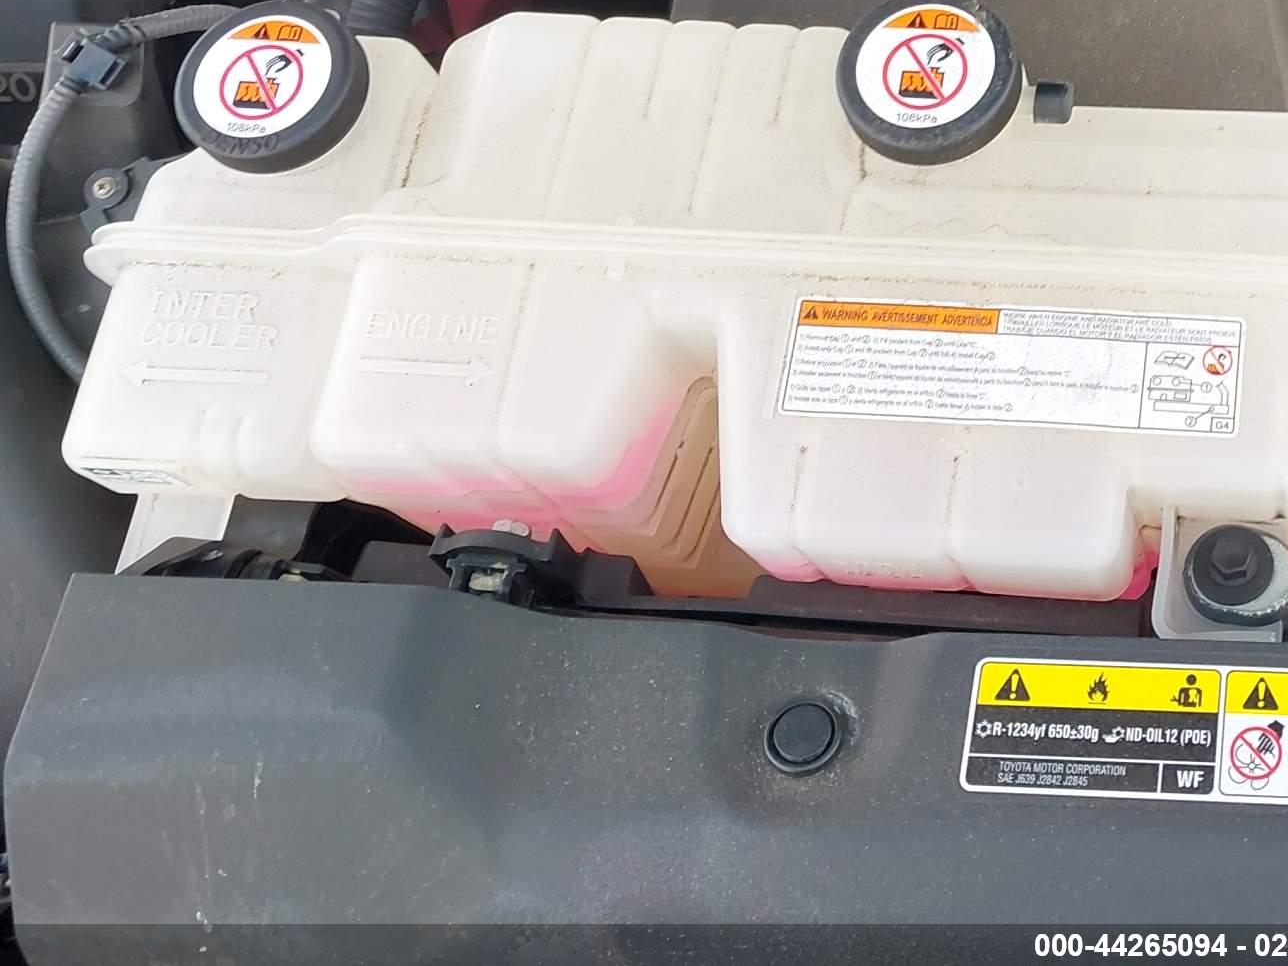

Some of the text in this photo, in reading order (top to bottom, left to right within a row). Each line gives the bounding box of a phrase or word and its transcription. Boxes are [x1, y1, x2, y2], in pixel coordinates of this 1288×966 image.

[896, 112, 939, 124] 108kPa
[226, 121, 267, 133] 108kPa
[151, 289, 261, 320] INTER
[822, 308, 869, 322] WARNING
[871, 310, 939, 325] AVERTISSEMENT
[364, 309, 502, 344] ENGINE
[142, 320, 280, 352] COOLER
[1215, 420, 1230, 430] G4
[993, 721, 1046, 741] R-1234yf
[1047, 724, 1100, 743] 650±30g
[1180, 729, 1212, 748] (POE)
[1000, 761, 1127, 776] TOYOTA MOTOR CORPORATION
[997, 772, 1089, 787] SAE J639 J2842 J2845
[1176, 770, 1205, 789] WF
